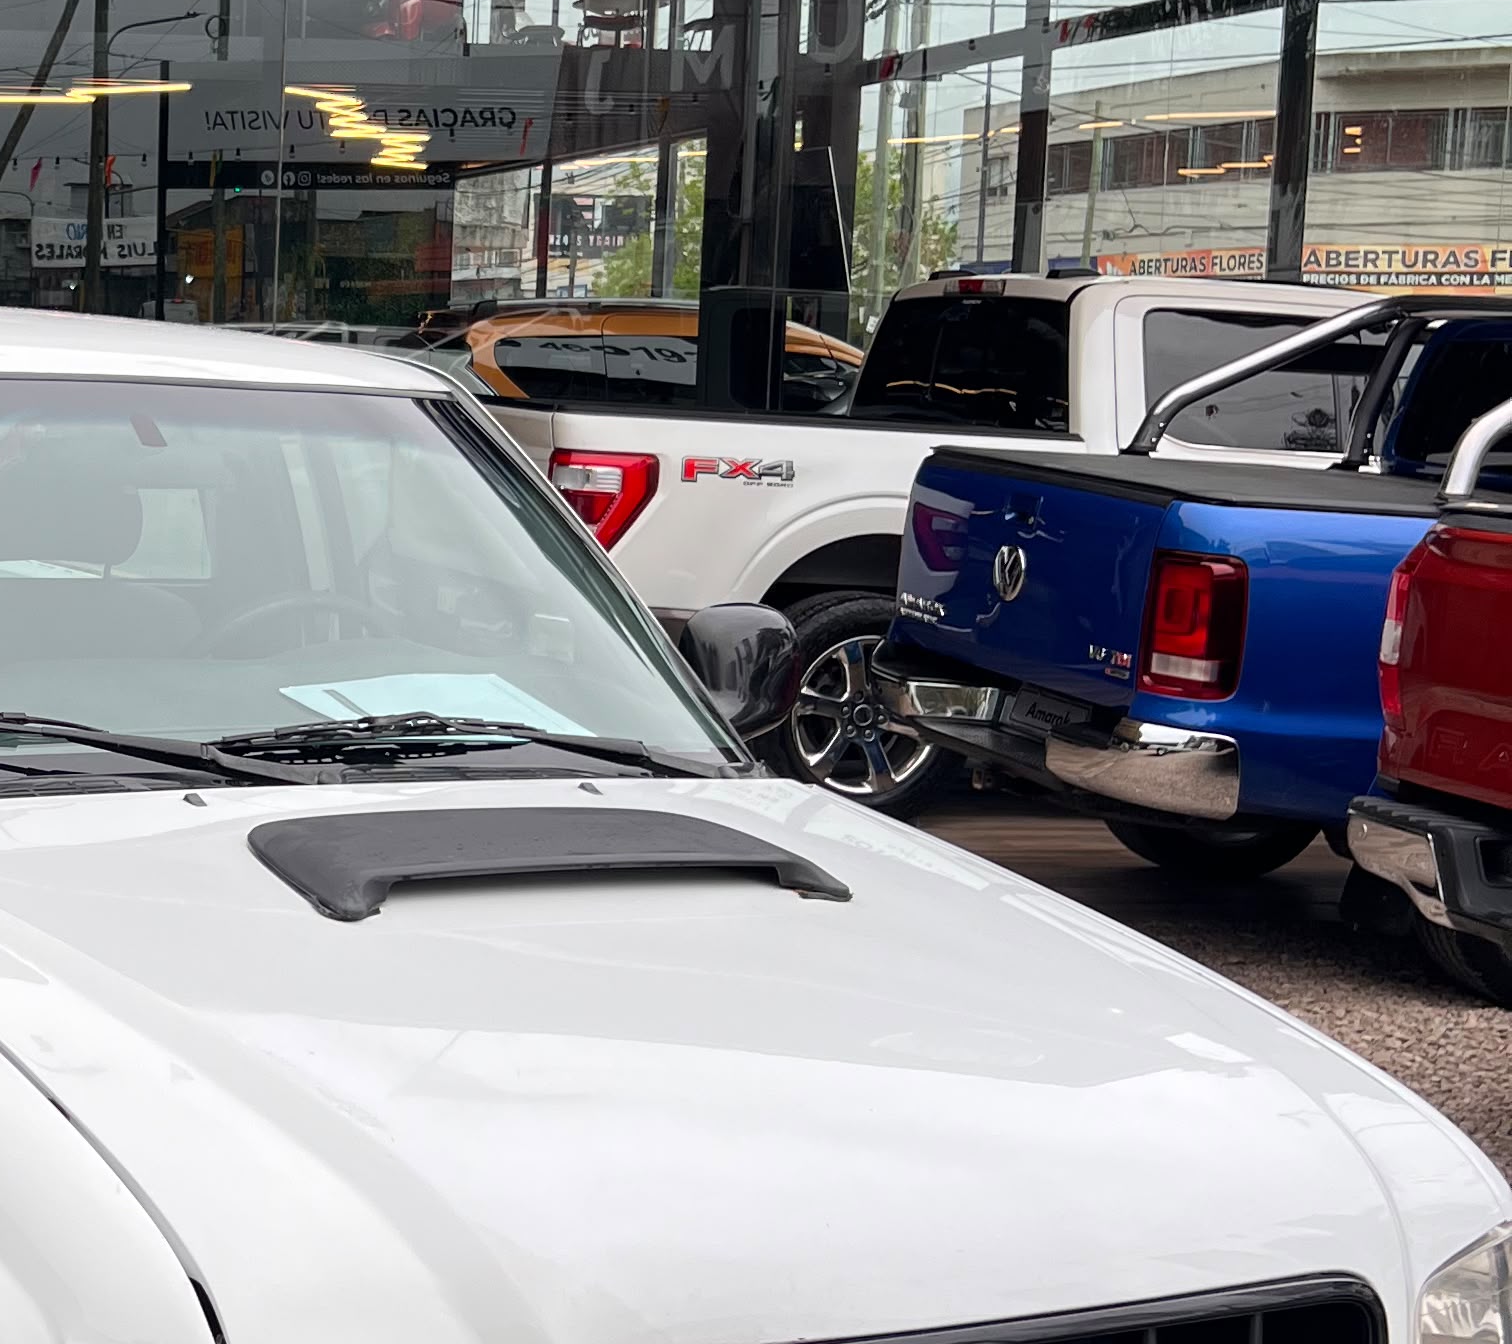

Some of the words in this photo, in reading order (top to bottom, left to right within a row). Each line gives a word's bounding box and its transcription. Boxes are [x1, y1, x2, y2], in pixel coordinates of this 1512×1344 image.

[1129, 254, 1207, 276] ABERTURAS
[1211, 252, 1264, 273] FLORES
[1303, 249, 1481, 269] ABERTURAS
[1303, 273, 1357, 286] PRECIOS
[1360, 274, 1376, 285] DE
[1380, 272, 1438, 286] FÁBRICA
[1441, 275, 1470, 286] CON
[1473, 275, 1491, 286] LA
[681, 455, 795, 483] FX4
